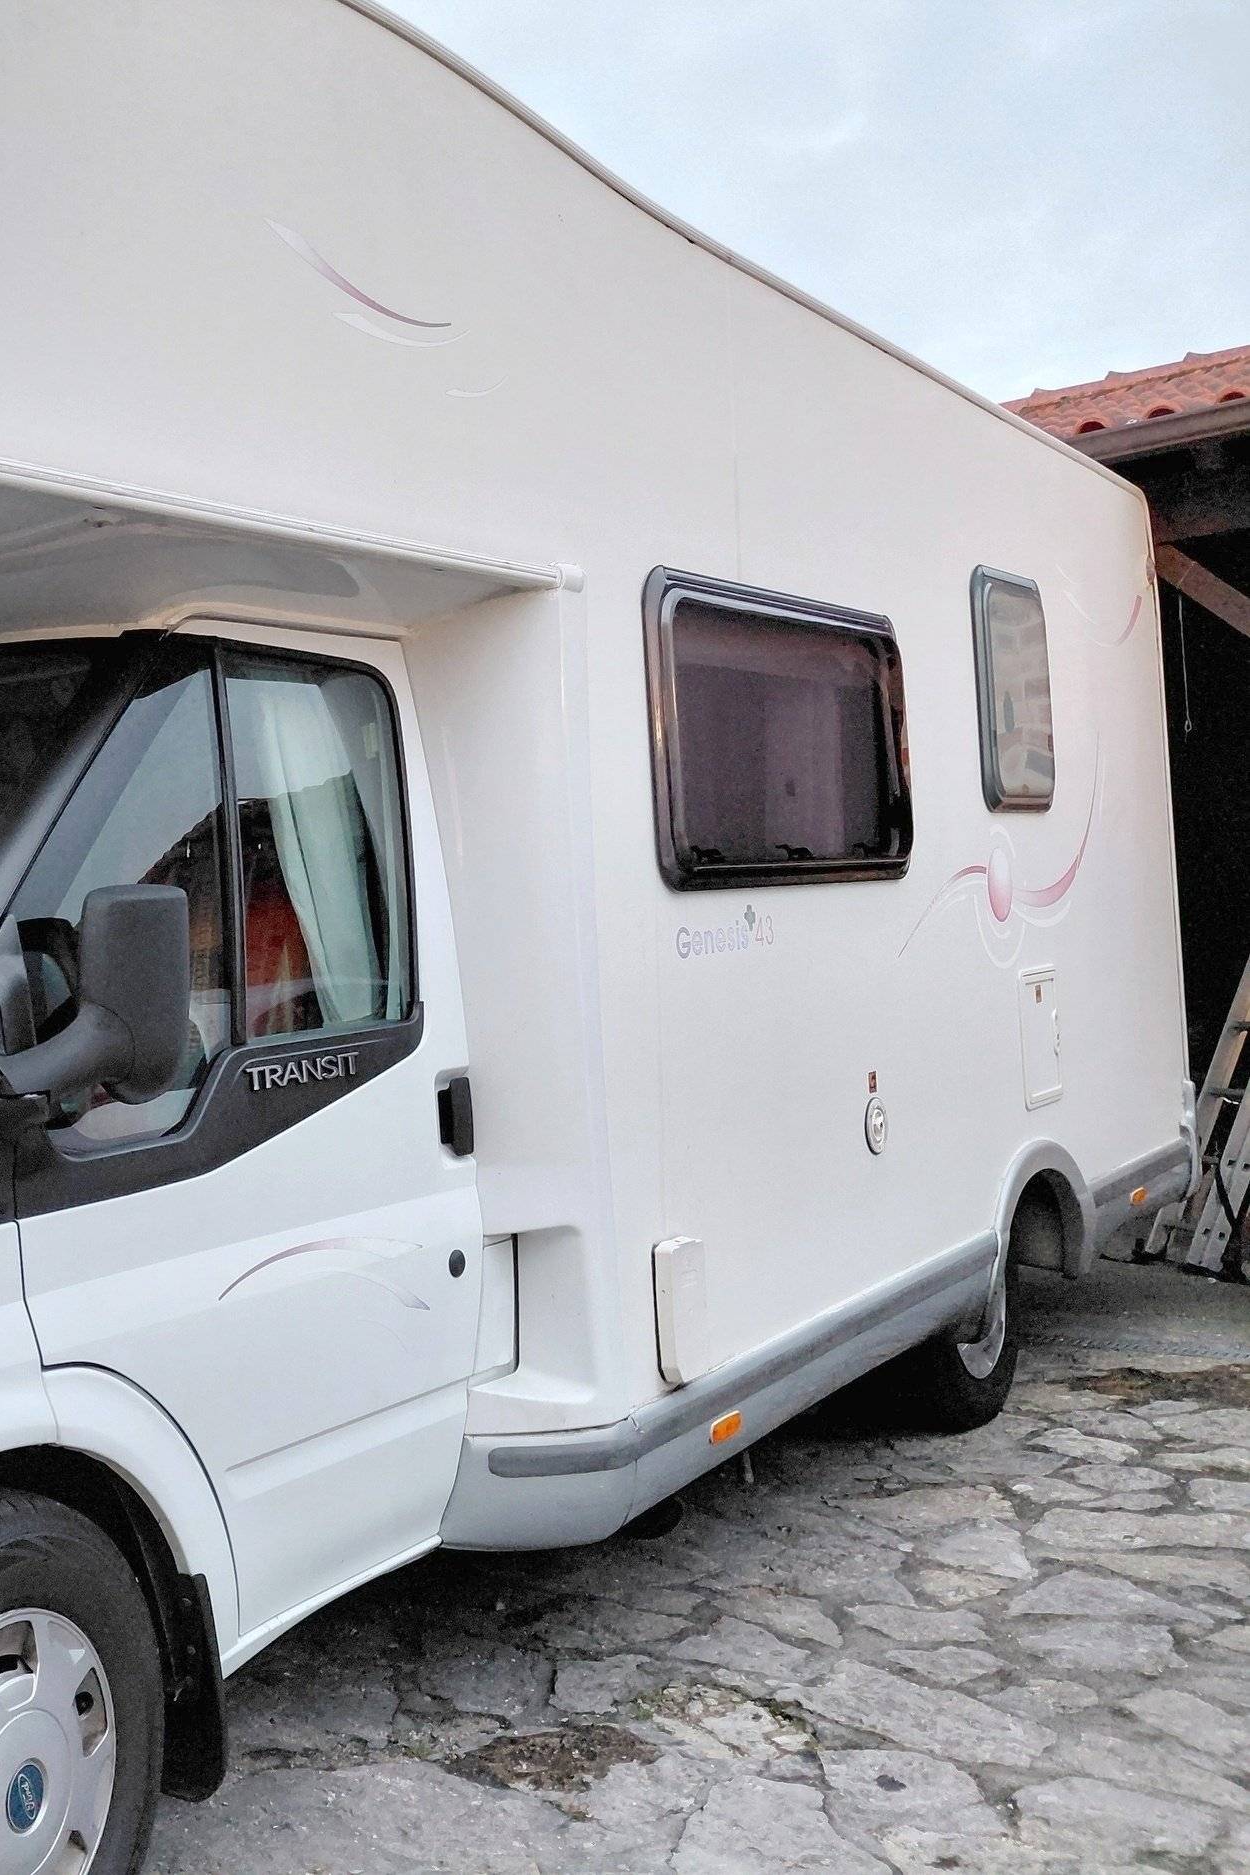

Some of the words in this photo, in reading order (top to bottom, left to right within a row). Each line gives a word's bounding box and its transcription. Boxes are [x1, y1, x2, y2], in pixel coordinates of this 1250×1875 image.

[676, 919, 749, 959] Genesis
[754, 915, 775, 946] 43
[245, 1051, 360, 1091] TRANSIT
